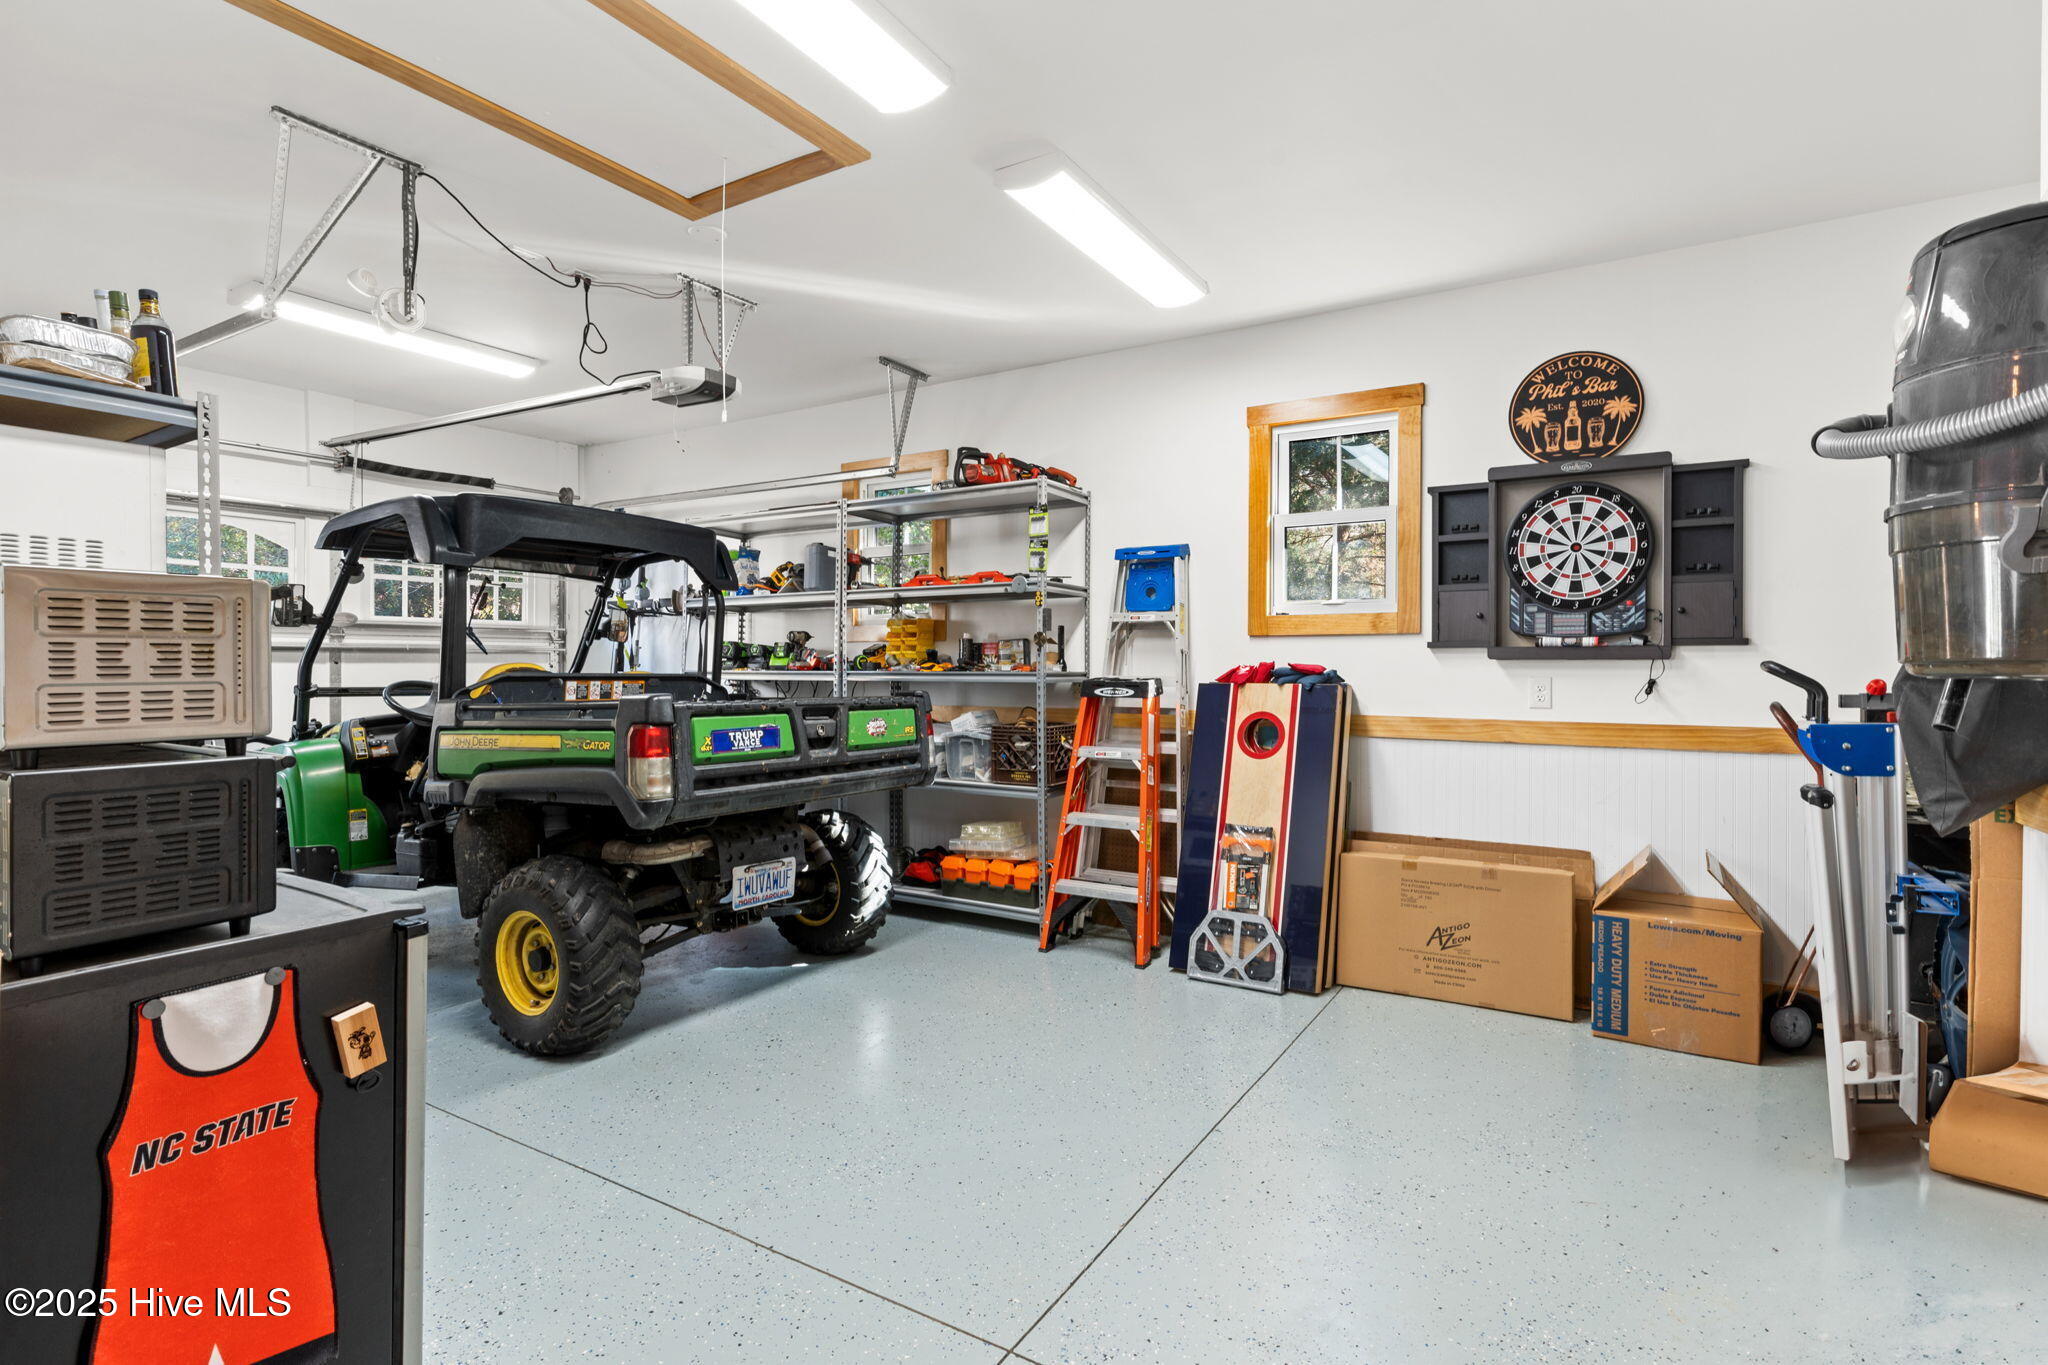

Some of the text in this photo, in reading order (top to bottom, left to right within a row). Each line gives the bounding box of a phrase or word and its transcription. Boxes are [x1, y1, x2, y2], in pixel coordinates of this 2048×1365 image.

[1530, 356, 1620, 383] WELCOME
[1564, 370, 1583, 380] TO
[1528, 376, 1619, 401] Phil's Bar
[1547, 398, 1605, 411] Est. 2020
[1553, 490, 1559, 498] 5
[1571, 485, 1582, 494] 20
[1595, 487, 1599, 495] 1
[1612, 494, 1620, 502] 18
[1534, 500, 1543, 508] 12
[1628, 506, 1634, 514] 4
[1522, 513, 1528, 521] 9
[1636, 522, 1645, 530] 13
[1511, 529, 1520, 538] 14
[1509, 547, 1517, 555] 11
[1636, 558, 1645, 567] 10
[1512, 564, 1518, 572] 8
[1521, 579, 1528, 587] 16
[1626, 575, 1635, 583] 15
[1613, 589, 1618, 597] 2
[1552, 598, 1560, 606] 19
[1573, 601, 1579, 609] 3
[1591, 598, 1601, 606] 17
[728, 730, 764, 741] TRUMP
[450, 735, 499, 747] JOHN DEERE
[582, 738, 611, 751] GATOR
[733, 738, 761, 747] VANCE
[738, 889, 790, 905] NORTH CAROLINA
[1426, 922, 1471, 946] ANTIGO
[1647, 921, 1742, 941] Lowes.com/Moving
[1440, 932, 1471, 951] ZEON
[1422, 956, 1482, 969] ANTIGOZEON.COM
[1649, 960, 1697, 973] Extra Strength
[1611, 921, 1623, 1031] HEAVY DUTY MEDIUM
[1649, 967, 1709, 980] Double Thickness
[1649, 973, 1662, 981] Use
[1676, 976, 1697, 987] Heavy
[1699, 980, 1718, 988] Items
[1649, 991, 1669, 999] Doble
[1673, 988, 1705, 999] Adicional
[1683, 1002, 1709, 1013] Objetos
[1711, 1007, 1741, 1018] Pesados
[130, 1097, 298, 1177] NC STATE
